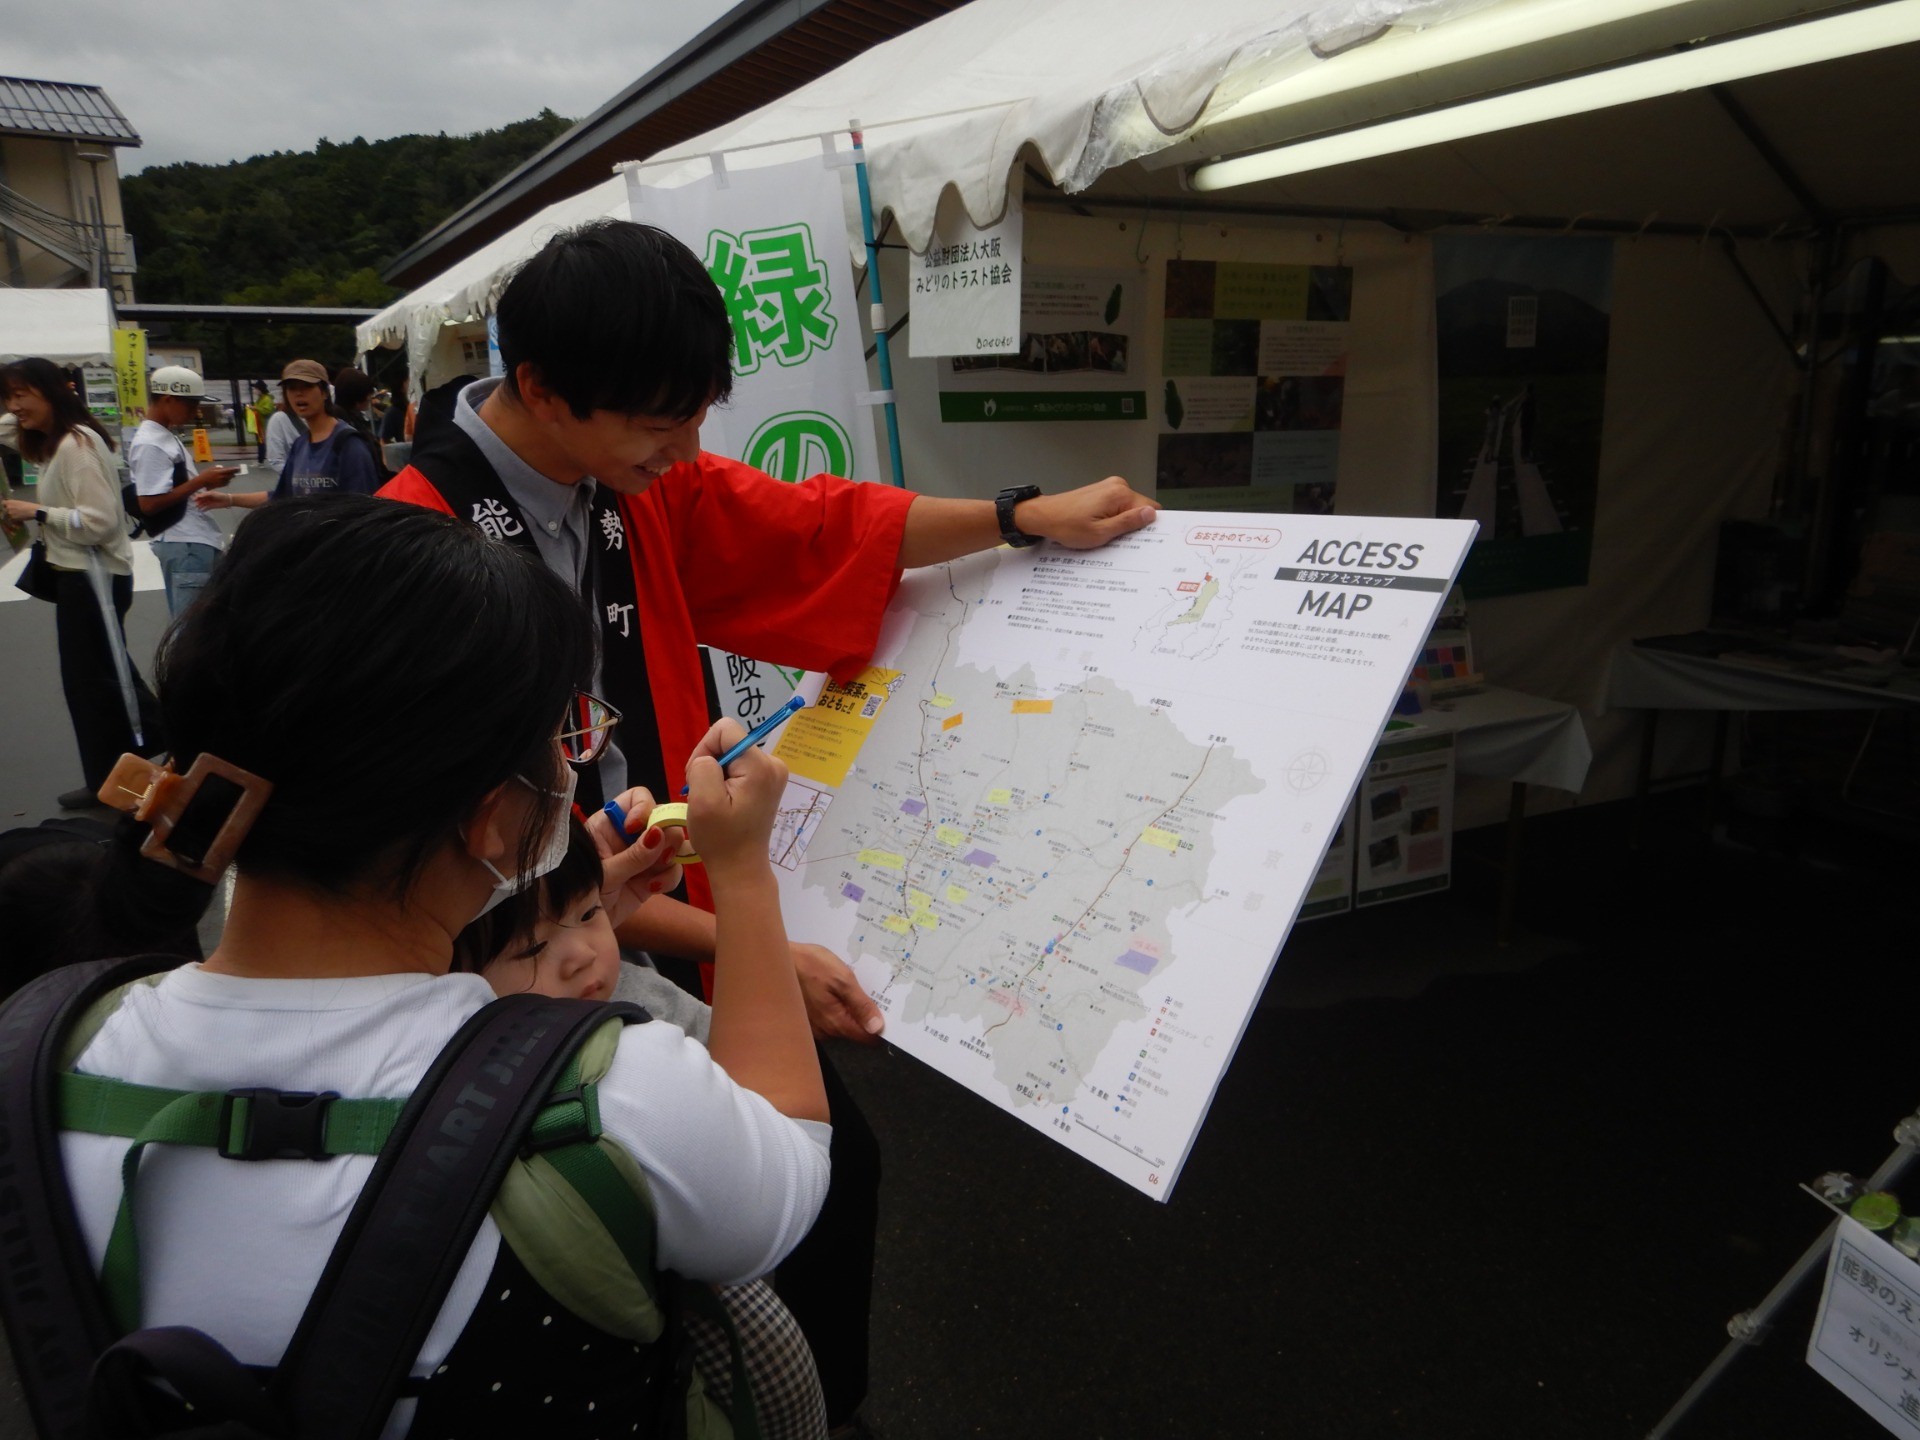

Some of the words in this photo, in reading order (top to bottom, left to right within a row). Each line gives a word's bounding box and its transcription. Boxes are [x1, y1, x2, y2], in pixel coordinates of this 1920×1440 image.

[916, 262, 1012, 294] みどりのトラスト協会
[170, 381, 191, 393] Era
[310, 476, 339, 488] OPEN
[472, 498, 524, 541] 能
[1193, 531, 1271, 545] おおさかのてっぺん
[1295, 539, 1424, 570] ACCESS
[1294, 569, 1396, 587] 能勢アクセスマップ
[1296, 589, 1373, 620] MAP
[1150, 697, 1173, 708] 小和田山
[1016, 1083, 1034, 1099] 妙見山
[1148, 1173, 1159, 1185] 06
[1842, 1255, 1920, 1324] 能勢のえ
[1848, 1324, 1920, 1391] オリジナ
